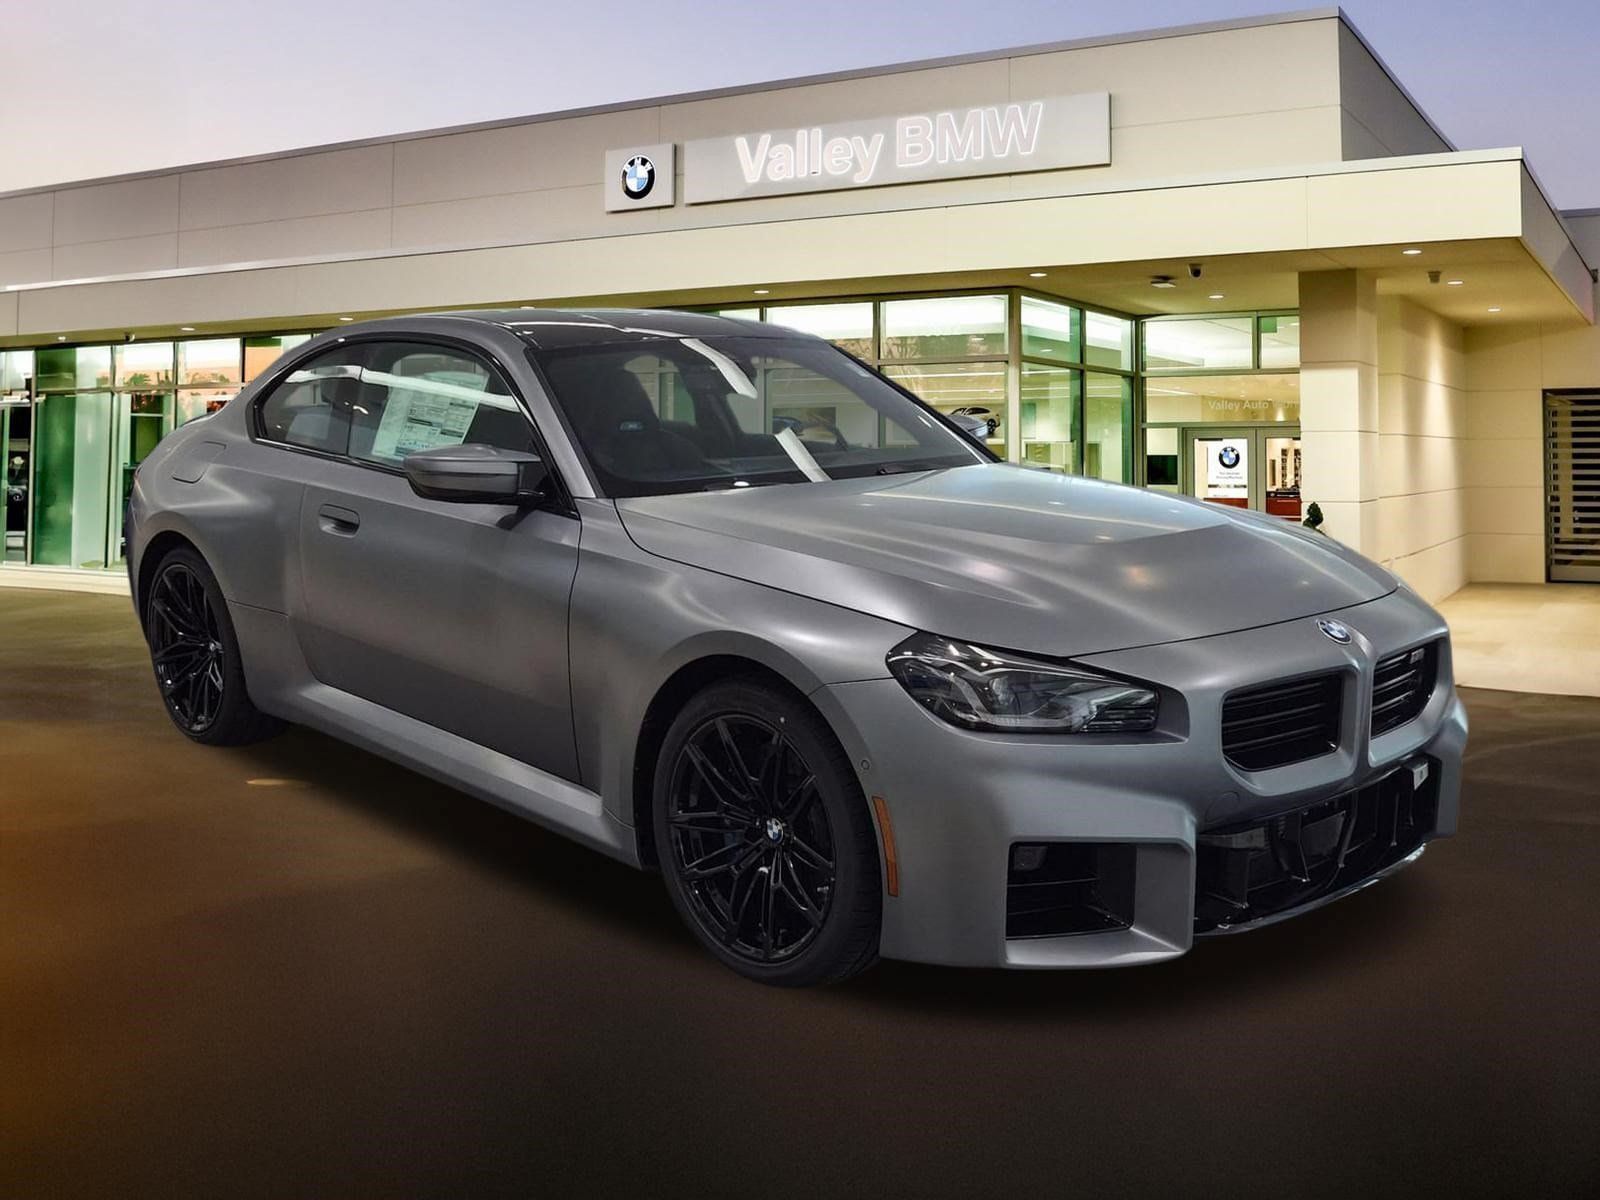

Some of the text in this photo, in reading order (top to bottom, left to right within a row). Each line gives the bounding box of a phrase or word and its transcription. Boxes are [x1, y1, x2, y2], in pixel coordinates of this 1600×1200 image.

[735, 102, 1044, 184] Valley BMW
[1208, 400, 1240, 412] Valley
[1243, 400, 1269, 409] Auto
